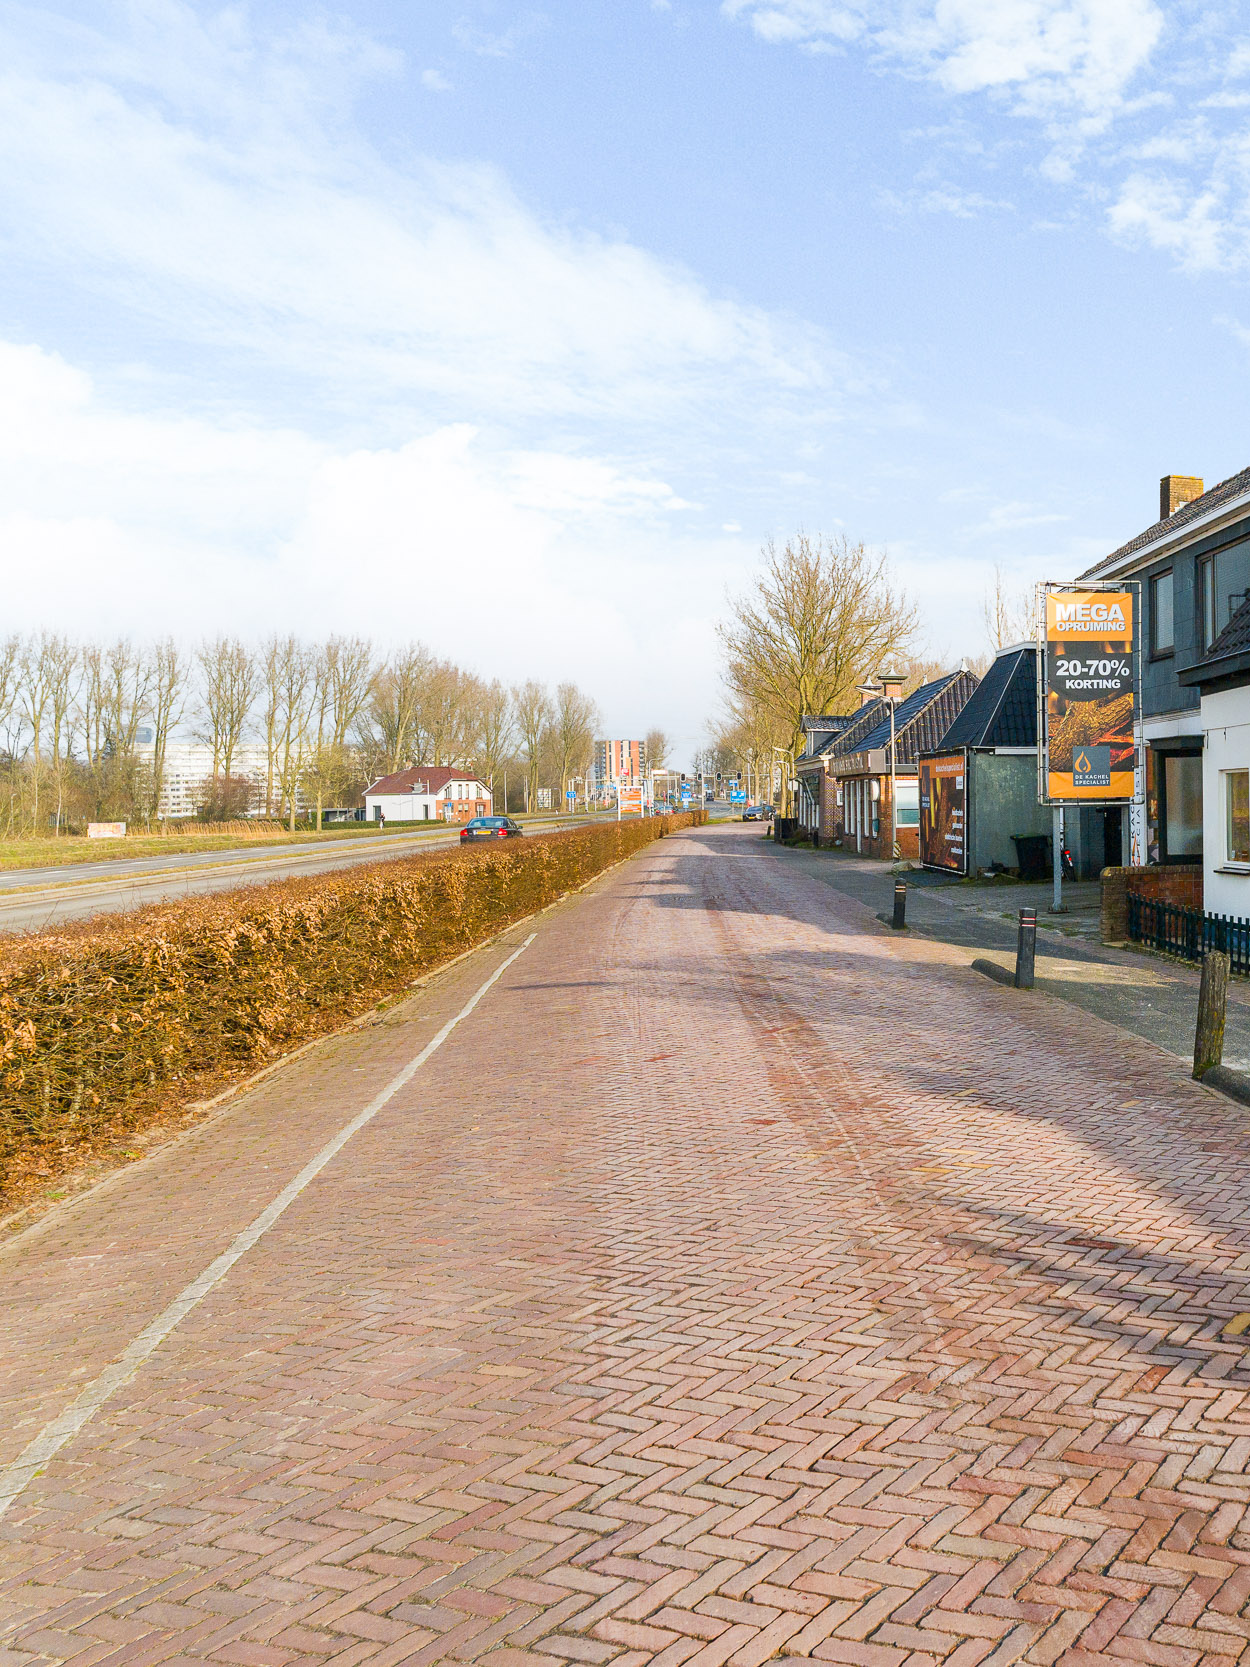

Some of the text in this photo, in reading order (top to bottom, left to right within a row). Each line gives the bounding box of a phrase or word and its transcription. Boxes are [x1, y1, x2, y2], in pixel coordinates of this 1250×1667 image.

[1055, 603, 1125, 621] MEGA
[1056, 621, 1126, 632] OPRUIMING
[1055, 659, 1130, 677] 20-70%
[1065, 679, 1121, 689] KORTING
